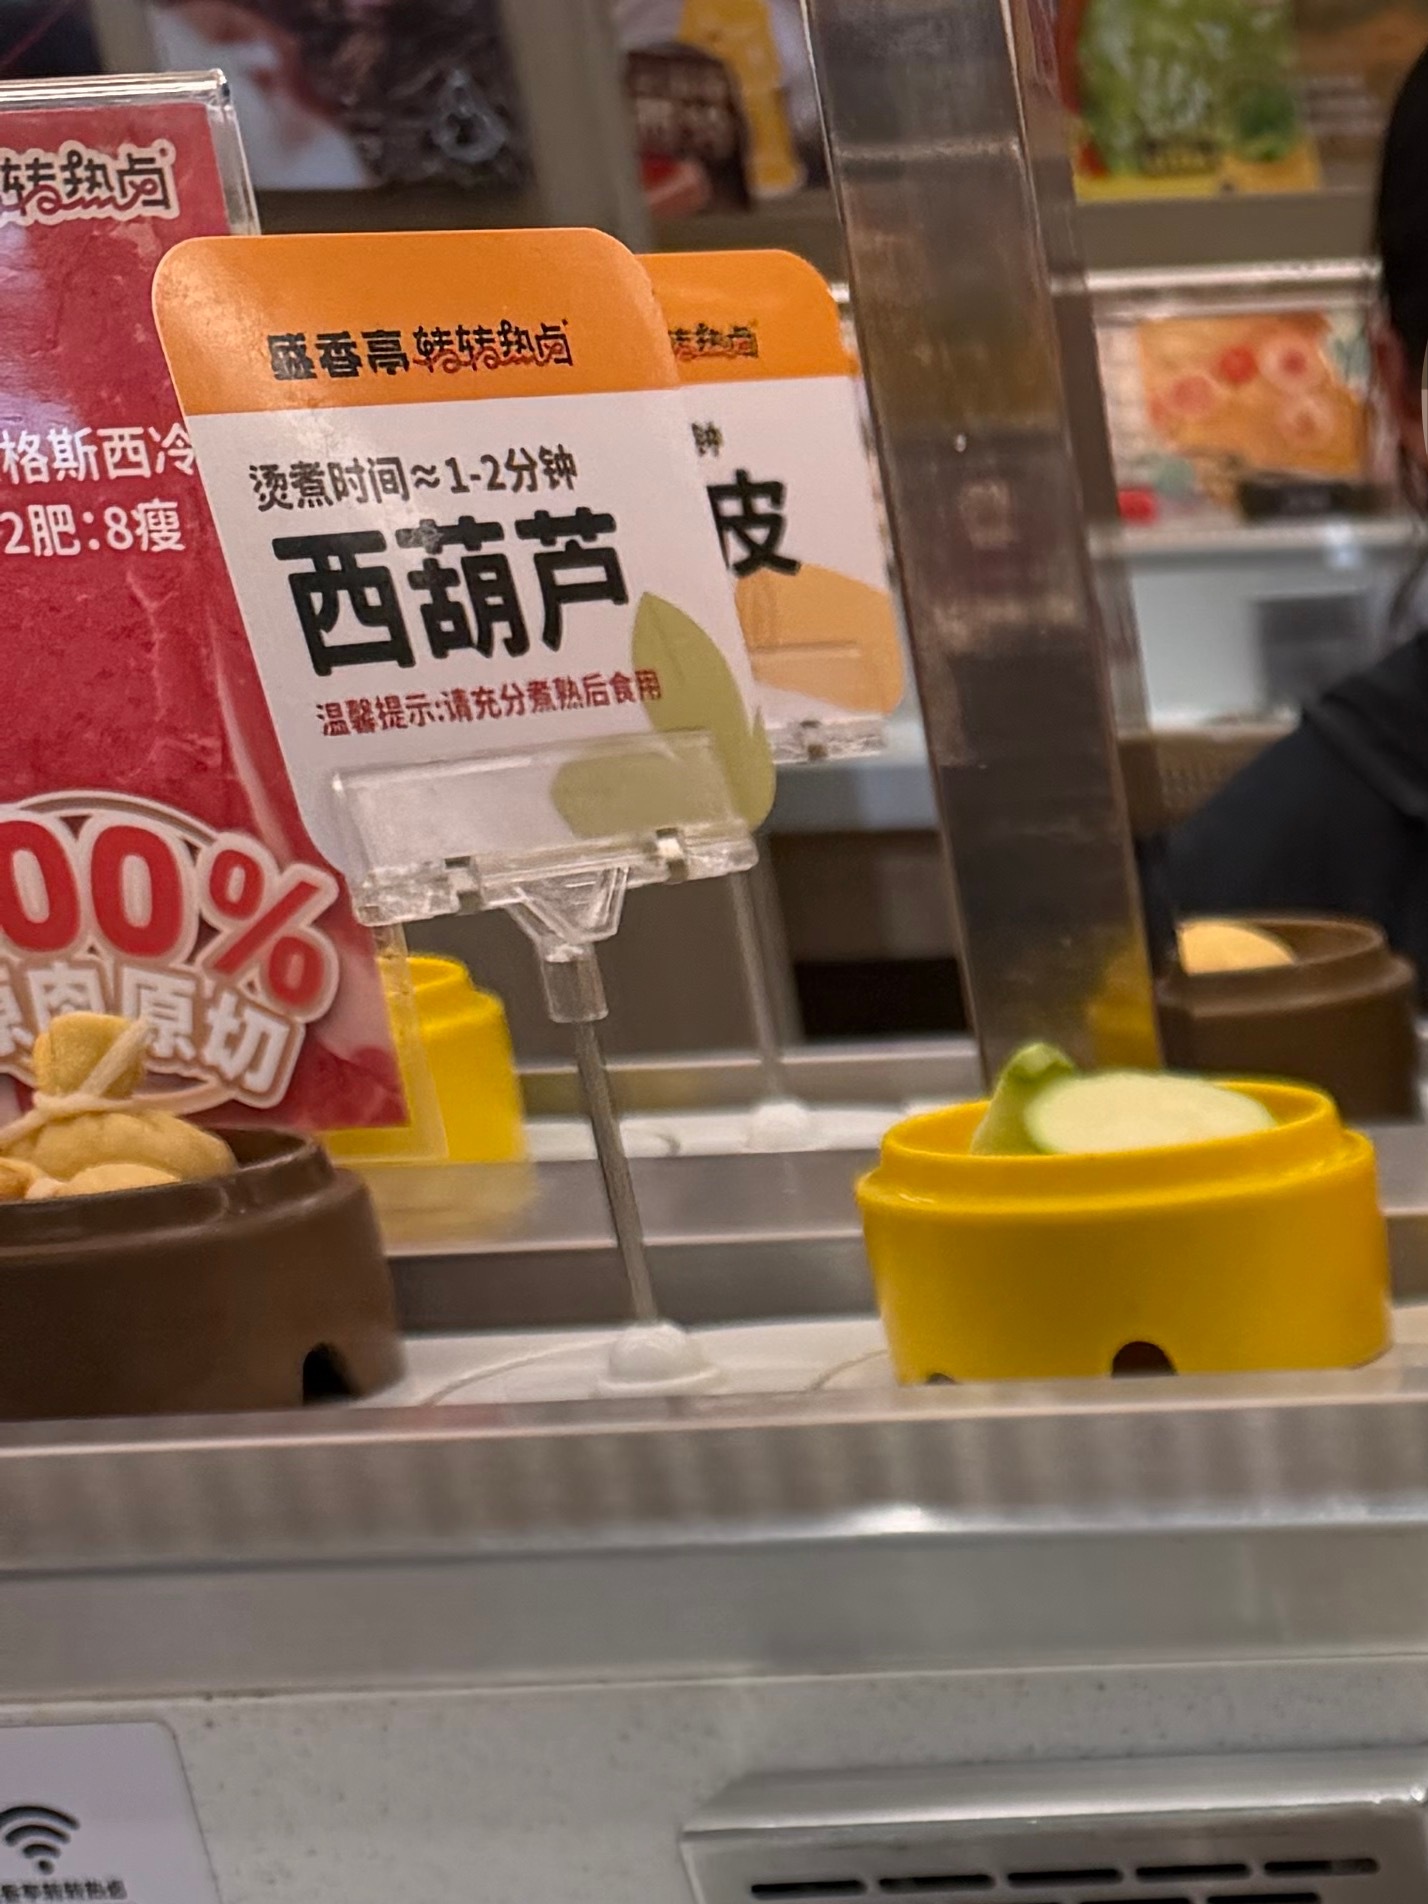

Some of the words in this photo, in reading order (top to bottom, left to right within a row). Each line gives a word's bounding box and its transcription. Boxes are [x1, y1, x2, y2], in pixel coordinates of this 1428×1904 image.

[249, 448, 578, 511] 烫煮时间≈1-2分钟
[706, 467, 802, 577] 皮
[273, 508, 628, 677] 西葫芦
